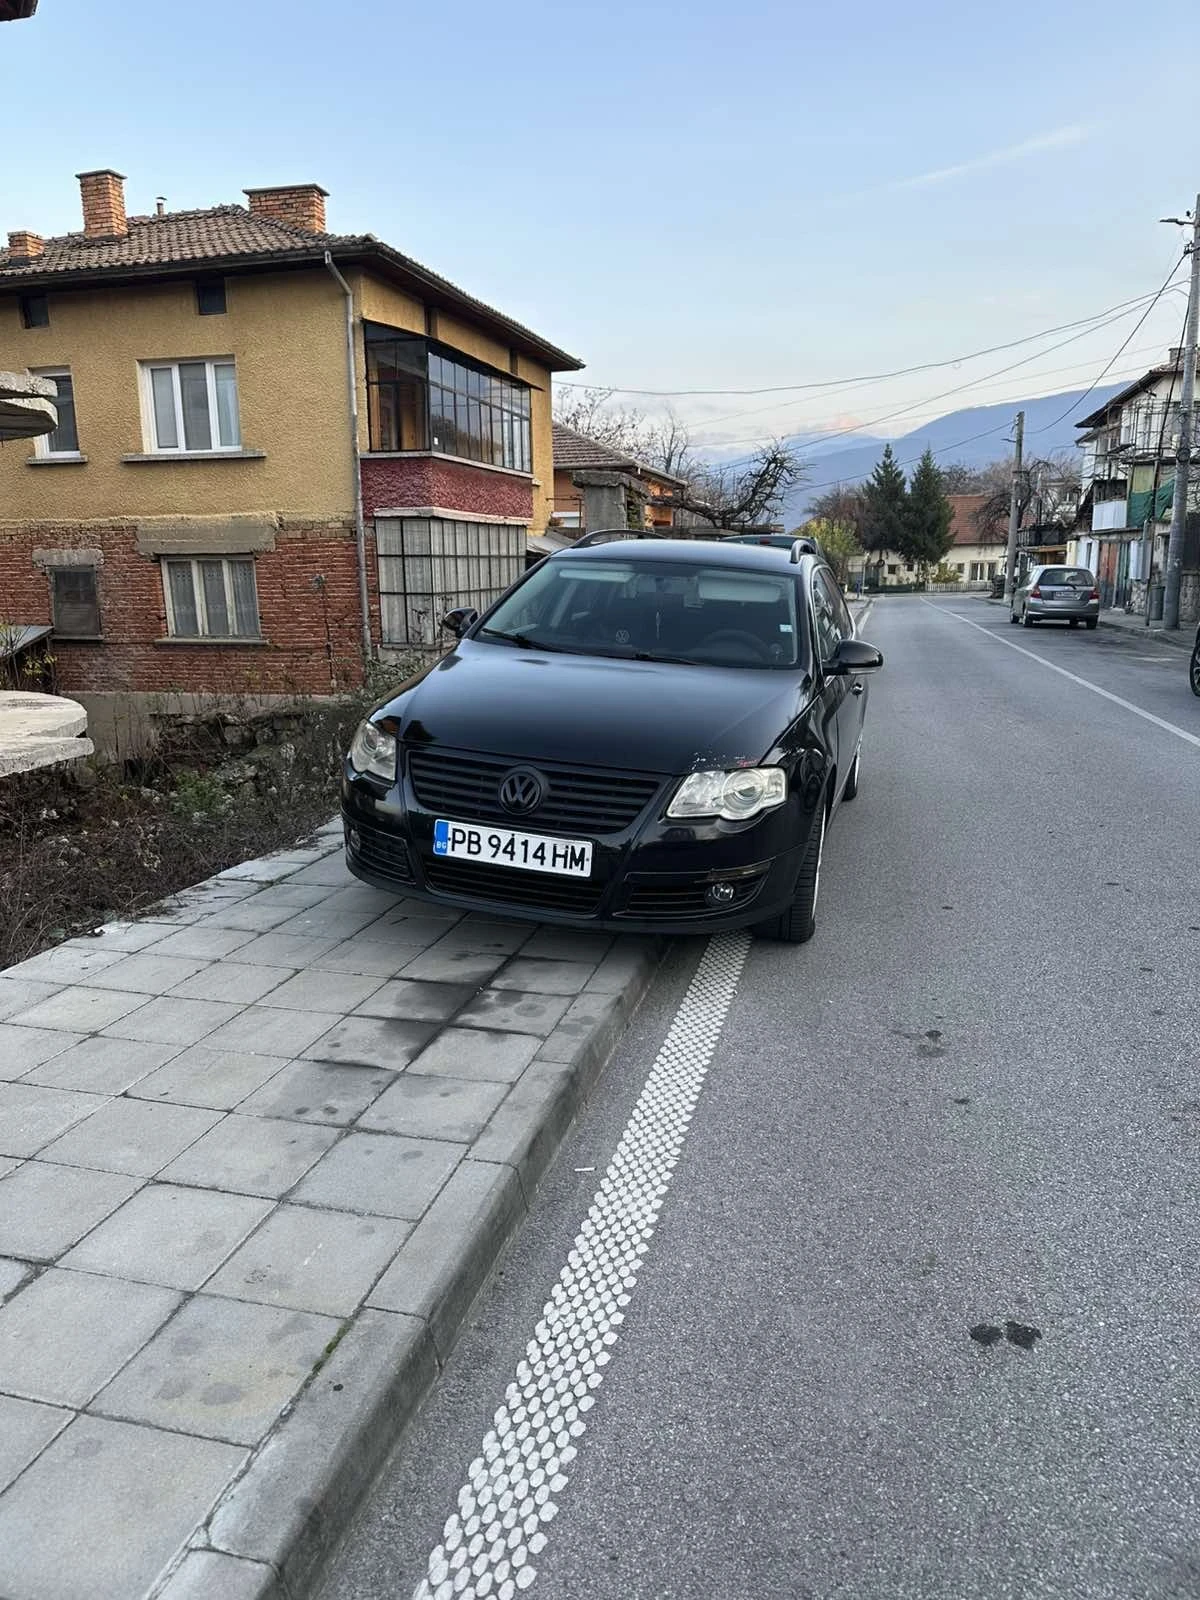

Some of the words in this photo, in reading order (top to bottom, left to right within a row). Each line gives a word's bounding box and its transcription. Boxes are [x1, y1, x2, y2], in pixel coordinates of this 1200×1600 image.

[501, 773, 541, 812] VW
[436, 840, 447, 849] BG
[451, 828, 482, 855] PB
[488, 834, 547, 866] 9414
[552, 844, 586, 872] HM
